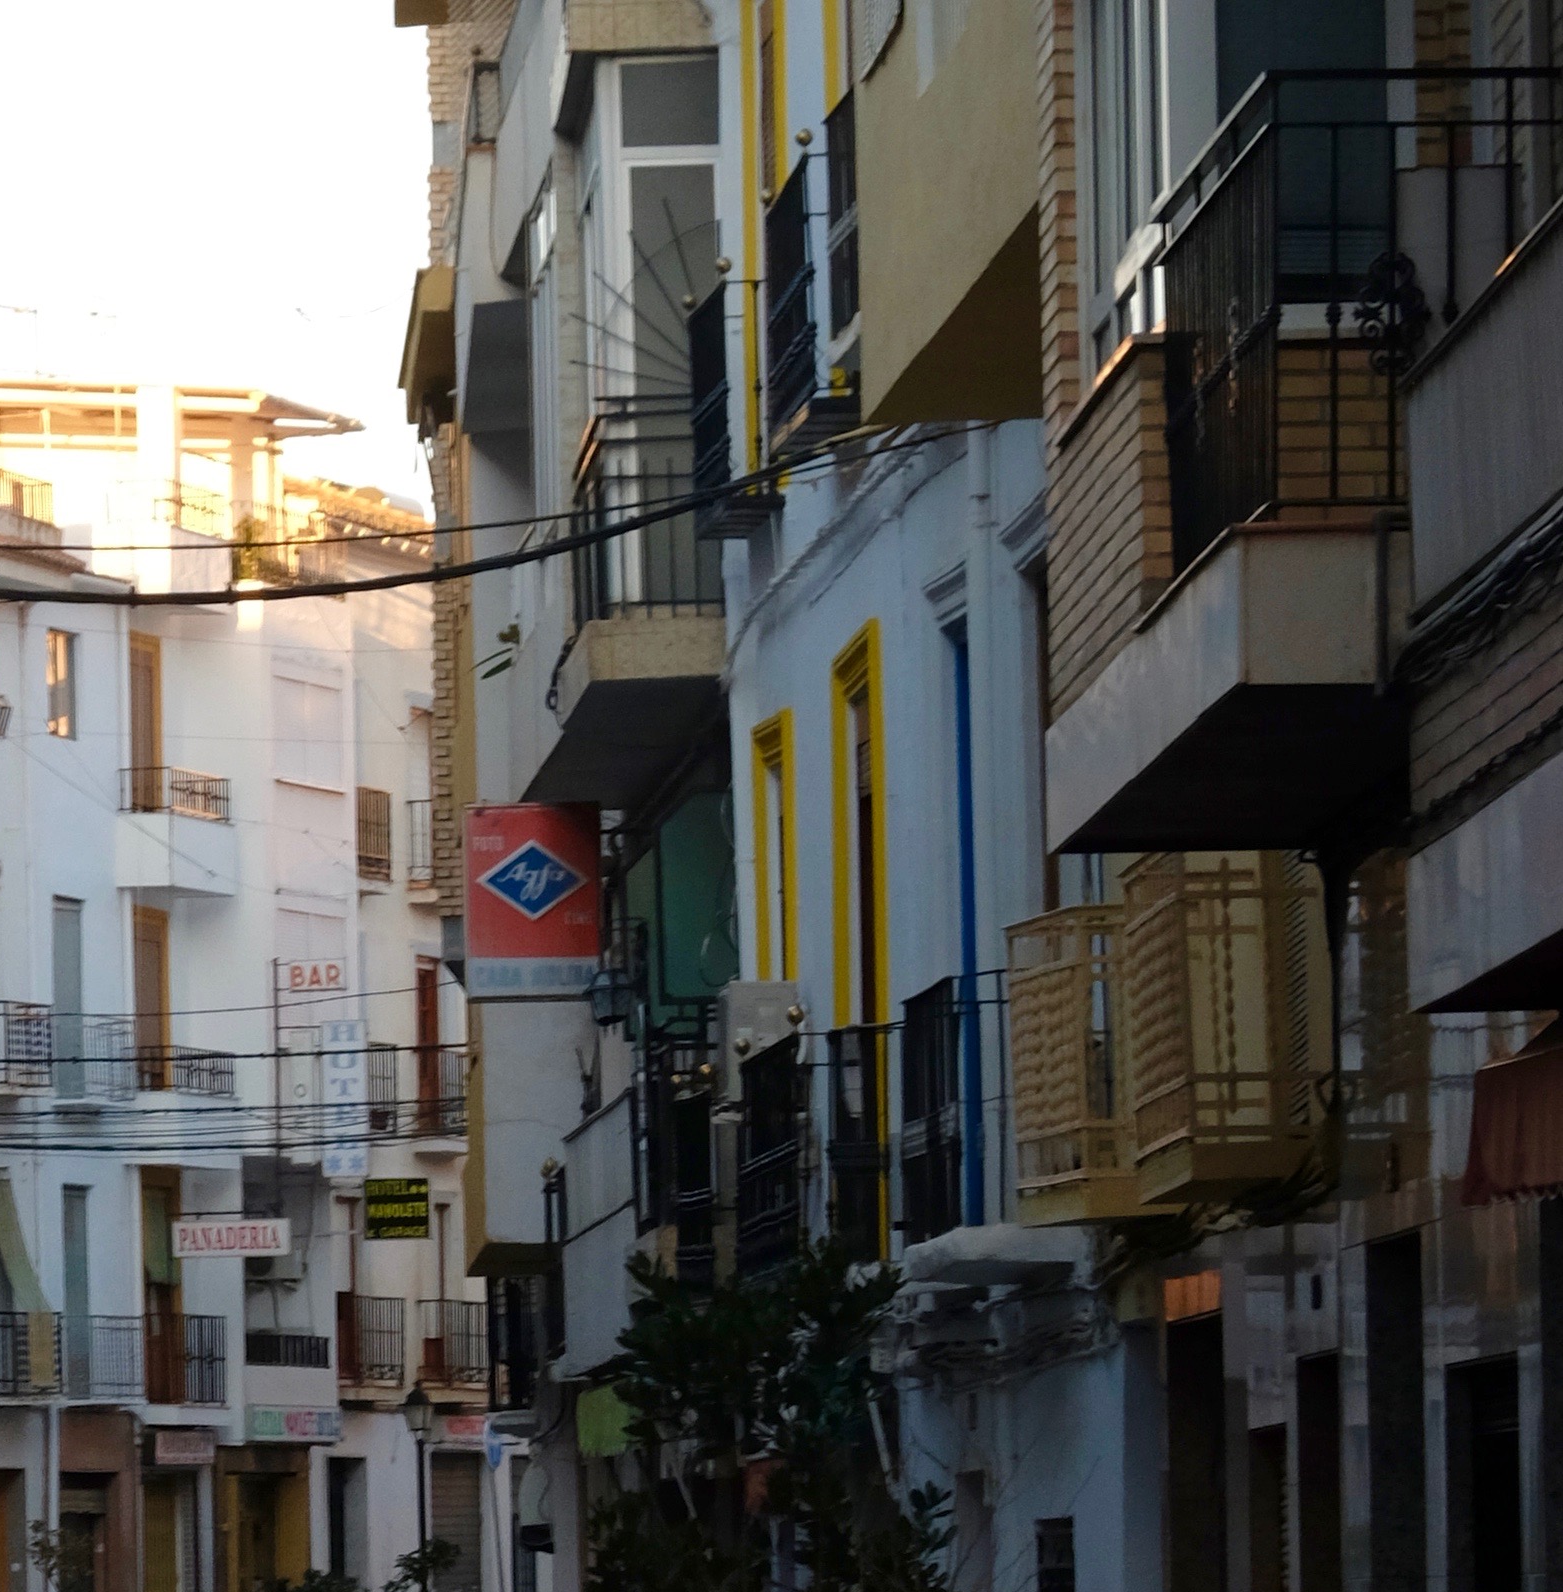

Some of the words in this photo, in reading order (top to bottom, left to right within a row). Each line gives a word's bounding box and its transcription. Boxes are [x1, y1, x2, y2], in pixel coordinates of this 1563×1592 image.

[496, 860, 566, 901] Agfa
[290, 963, 342, 988] BAR
[179, 1226, 281, 1251] PANADERIA
